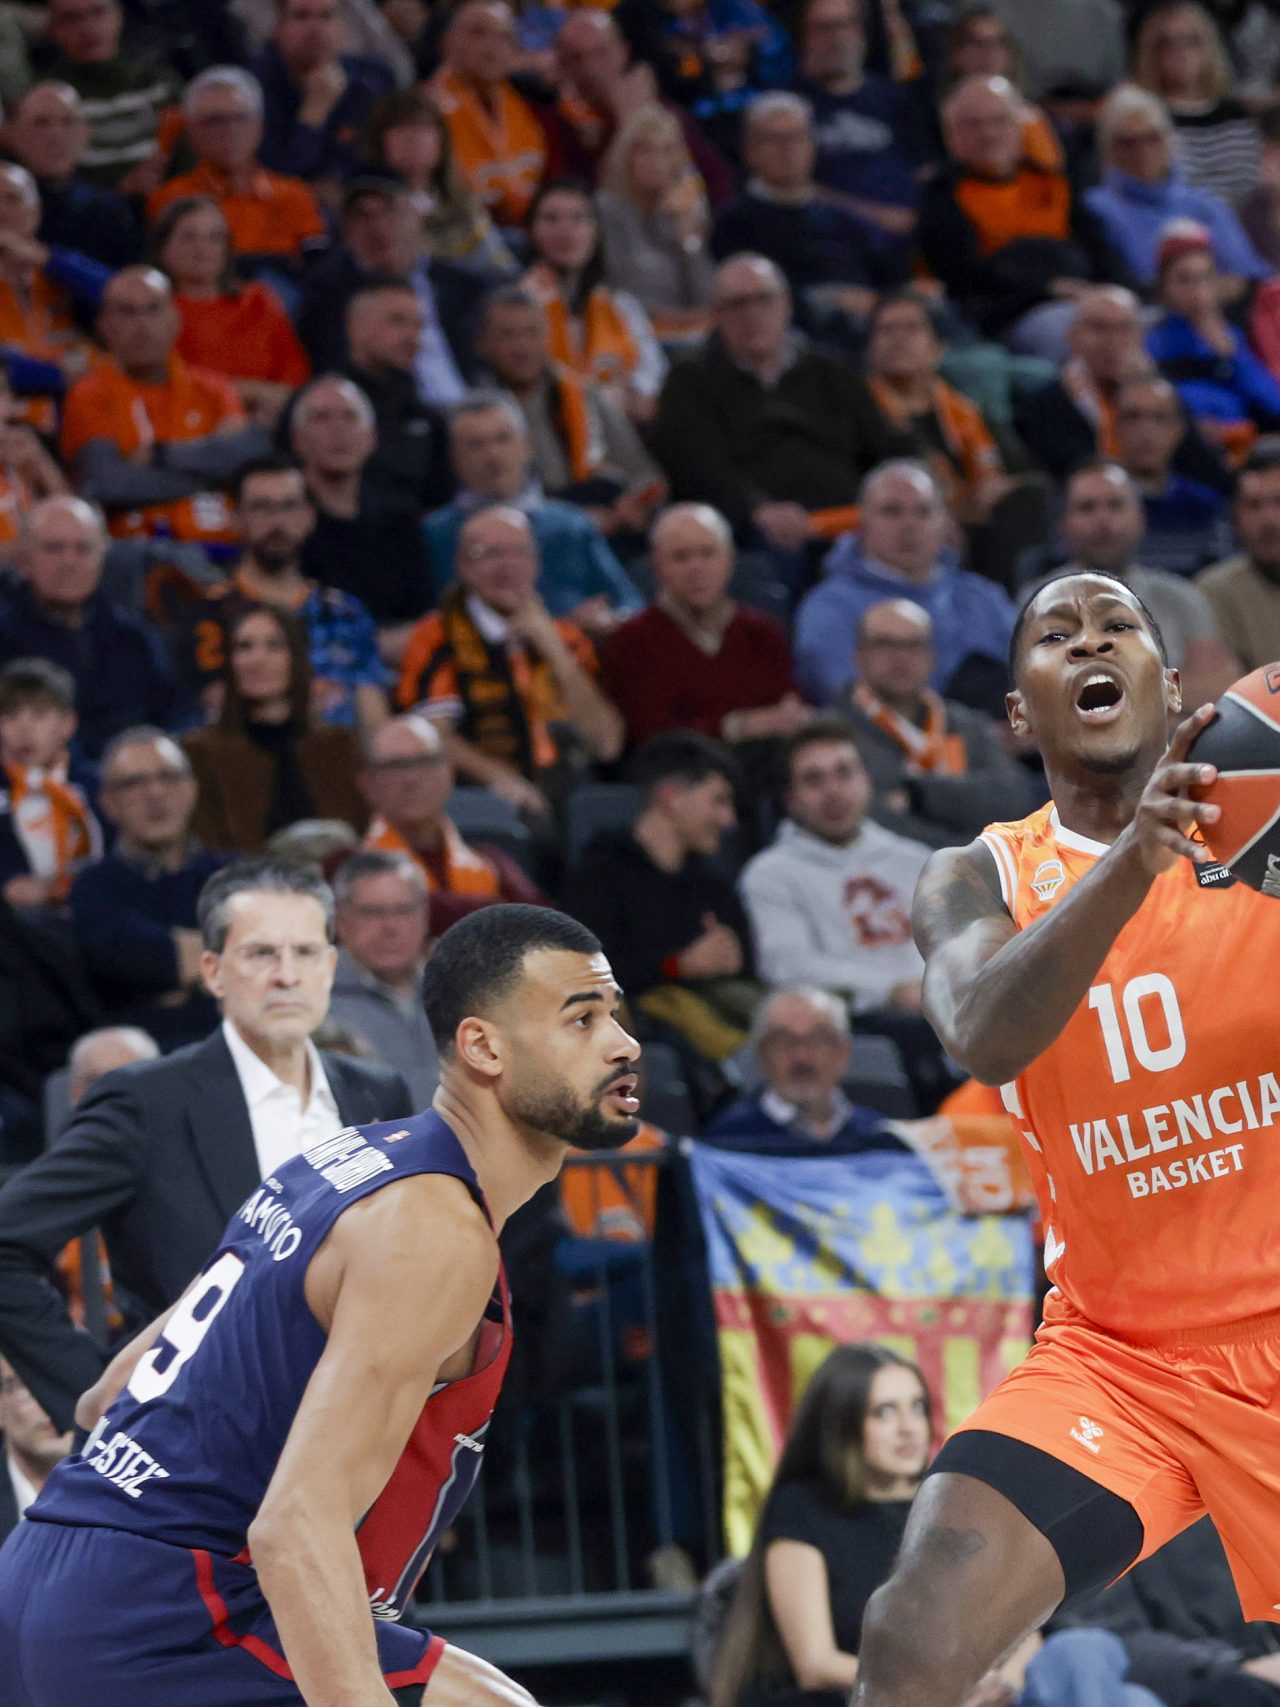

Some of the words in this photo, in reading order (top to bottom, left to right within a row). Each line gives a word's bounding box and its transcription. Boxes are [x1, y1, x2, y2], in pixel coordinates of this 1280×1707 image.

[1088, 972, 1187, 1084] 10
[1126, 1143, 1245, 1199] BASKET
[127, 1252, 246, 1404] 9
